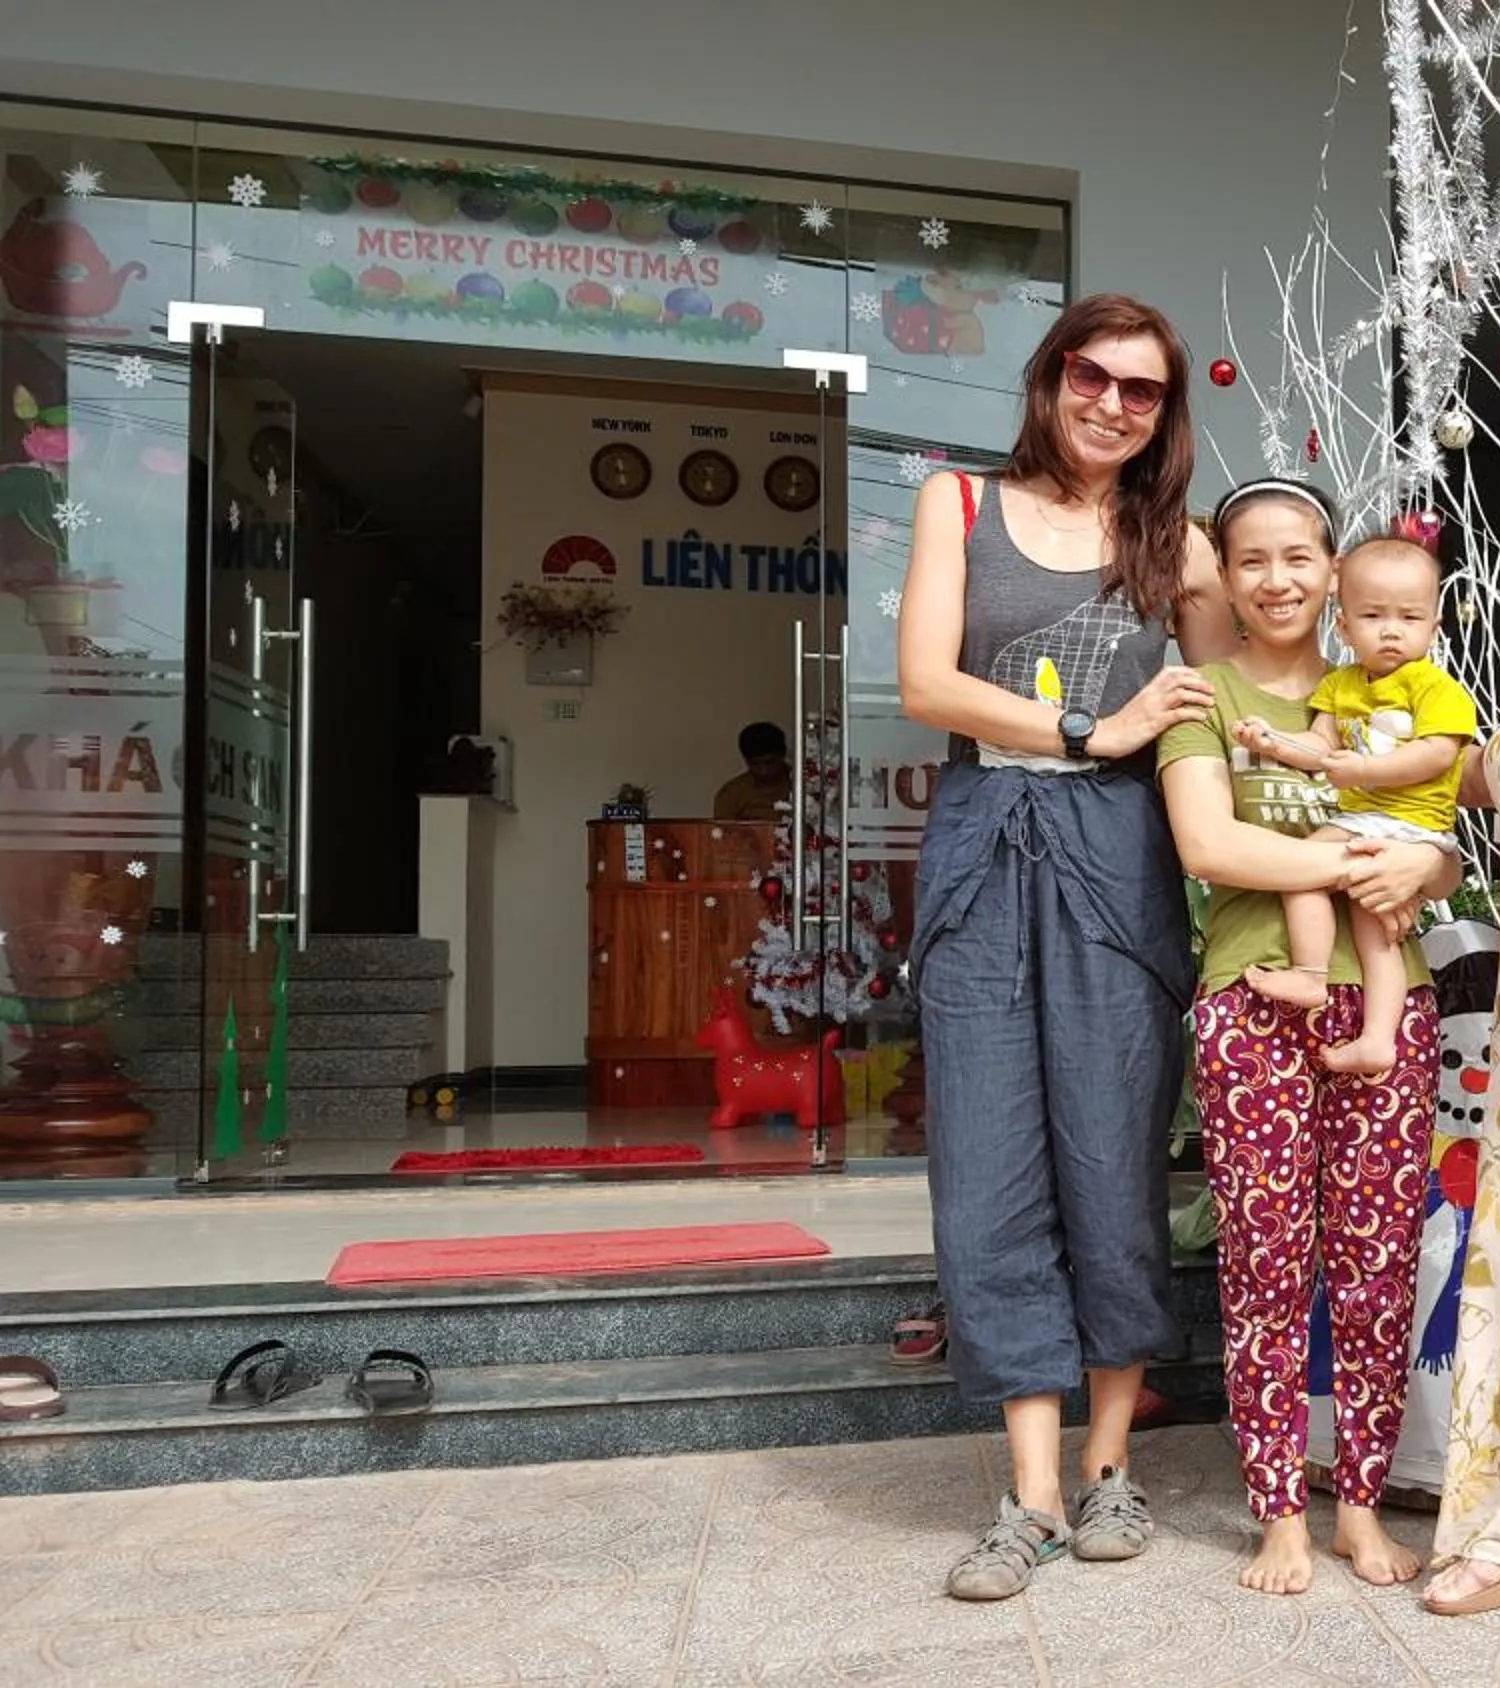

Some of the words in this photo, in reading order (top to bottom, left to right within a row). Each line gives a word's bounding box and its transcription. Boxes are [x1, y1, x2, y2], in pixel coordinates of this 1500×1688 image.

[357, 226, 493, 266] MERRY
[505, 239, 720, 287] CHRISTMAS
[592, 418, 618, 432] NEW
[621, 420, 651, 433] YORK
[690, 424, 729, 439] TOKYO
[642, 528, 732, 590] LIÊN
